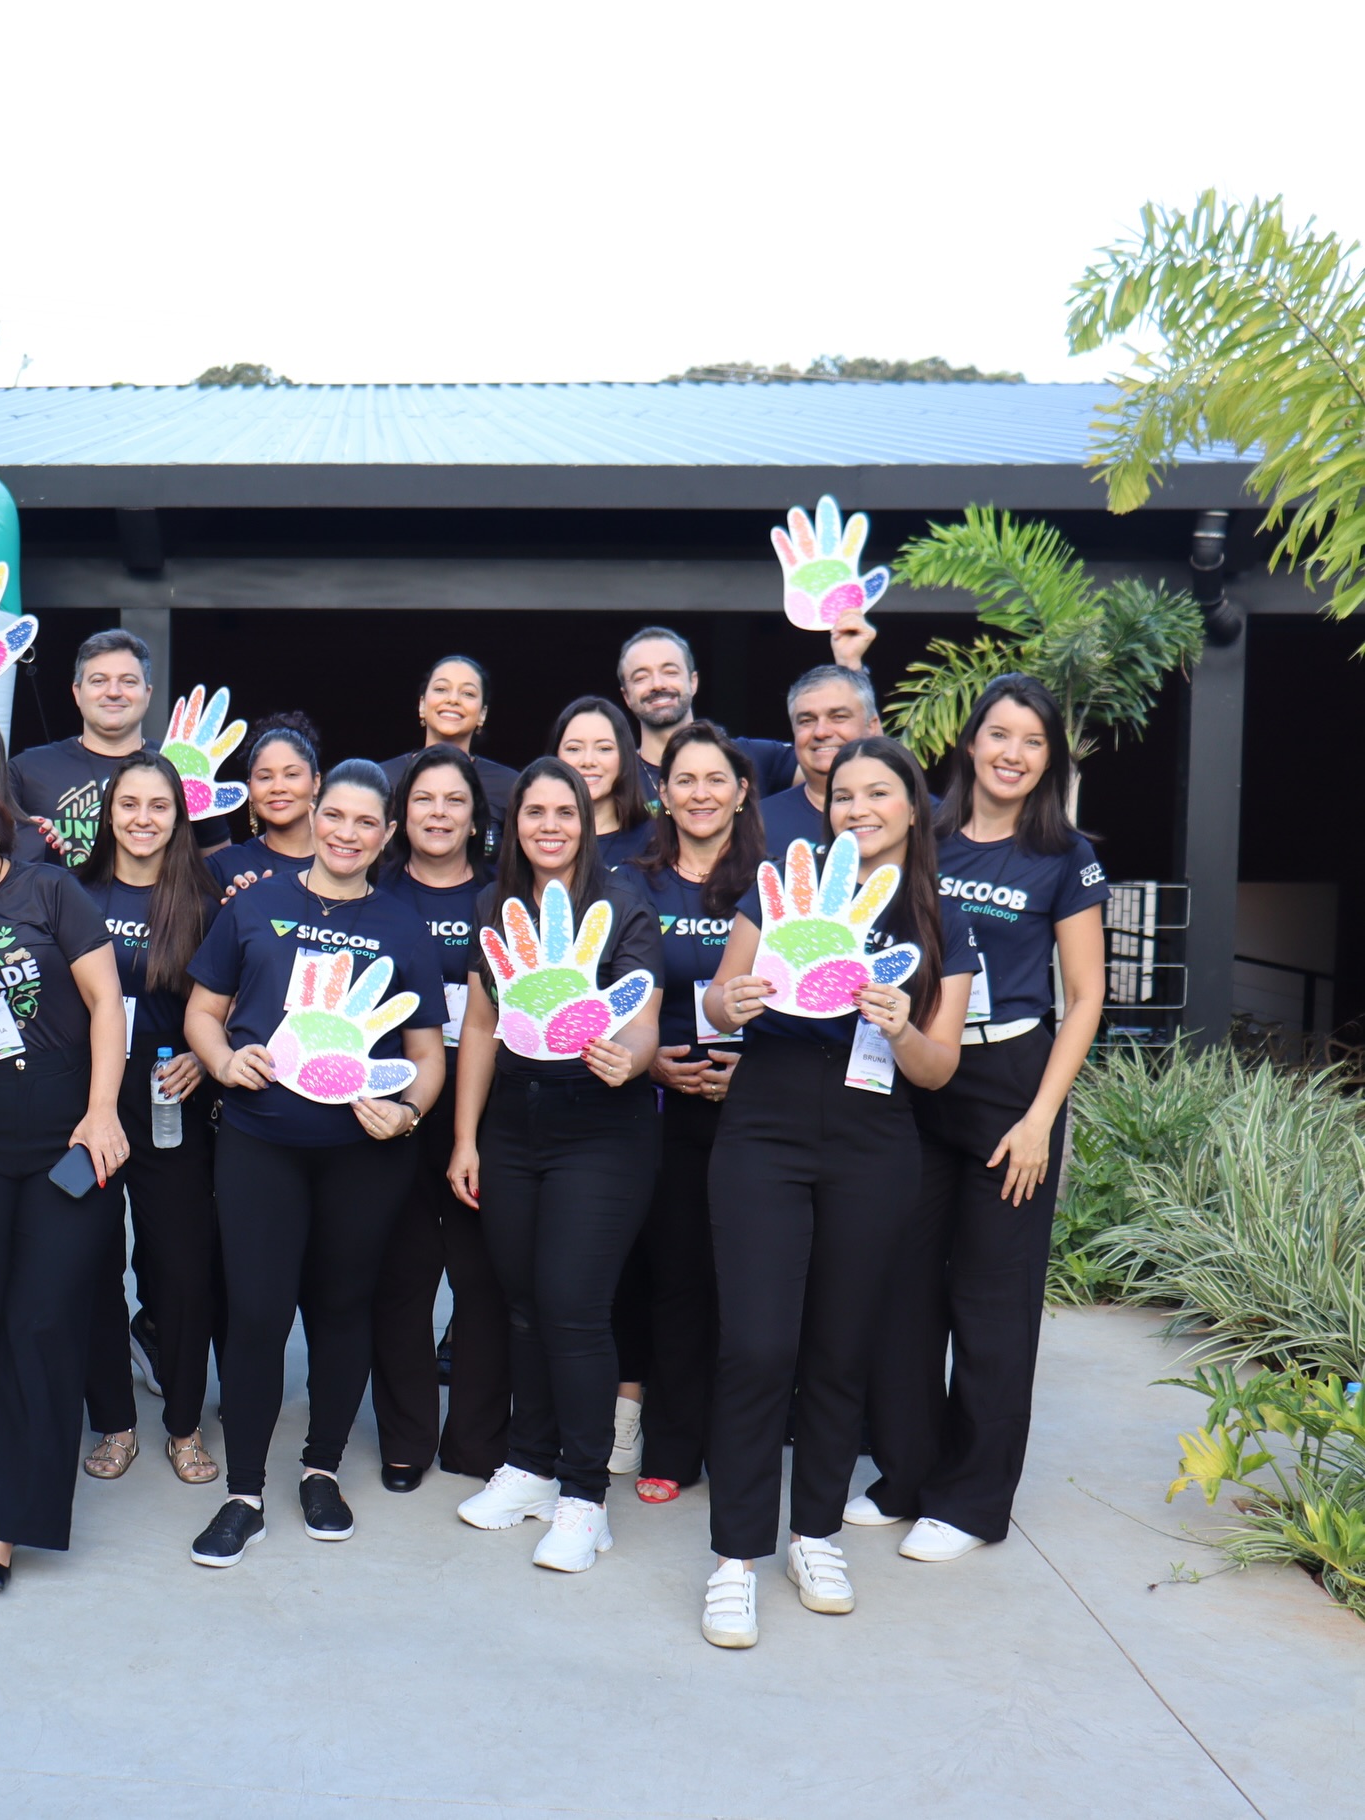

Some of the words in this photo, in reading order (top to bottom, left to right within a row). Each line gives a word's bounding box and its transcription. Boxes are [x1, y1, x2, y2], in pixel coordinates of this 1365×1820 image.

[938, 877, 1028, 910] SICOOB
[961, 902, 1019, 923] Credicoop
[296, 925, 380, 950] SICOOB
[862, 1053, 887, 1064] BRUNA
